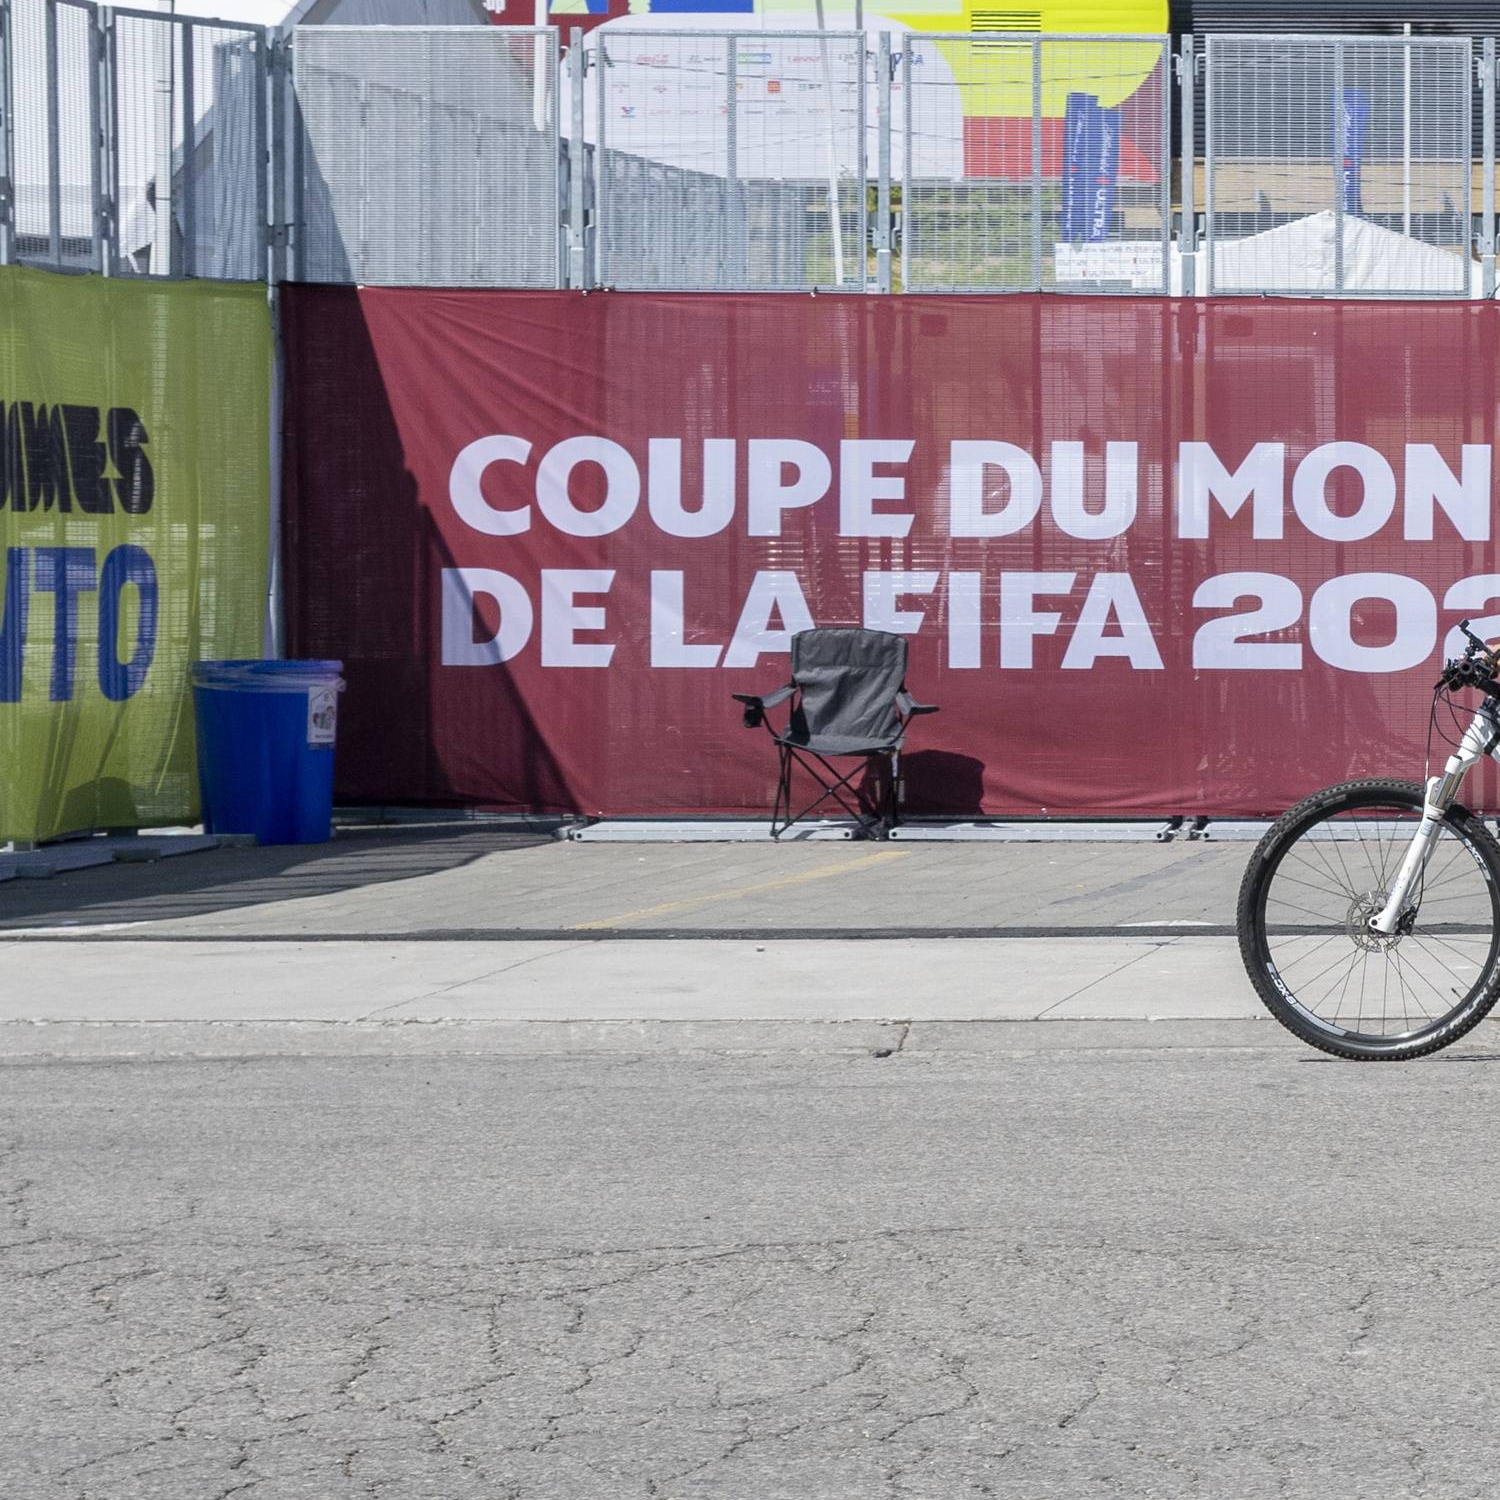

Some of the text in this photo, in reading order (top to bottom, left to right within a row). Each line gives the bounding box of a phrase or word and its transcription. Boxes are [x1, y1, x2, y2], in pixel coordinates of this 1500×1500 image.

[449, 434, 916, 538] COUPE
[950, 440, 1137, 542] DU
[442, 567, 617, 667] DE
[650, 571, 814, 668] LA
[863, 571, 1162, 669] FIFA
